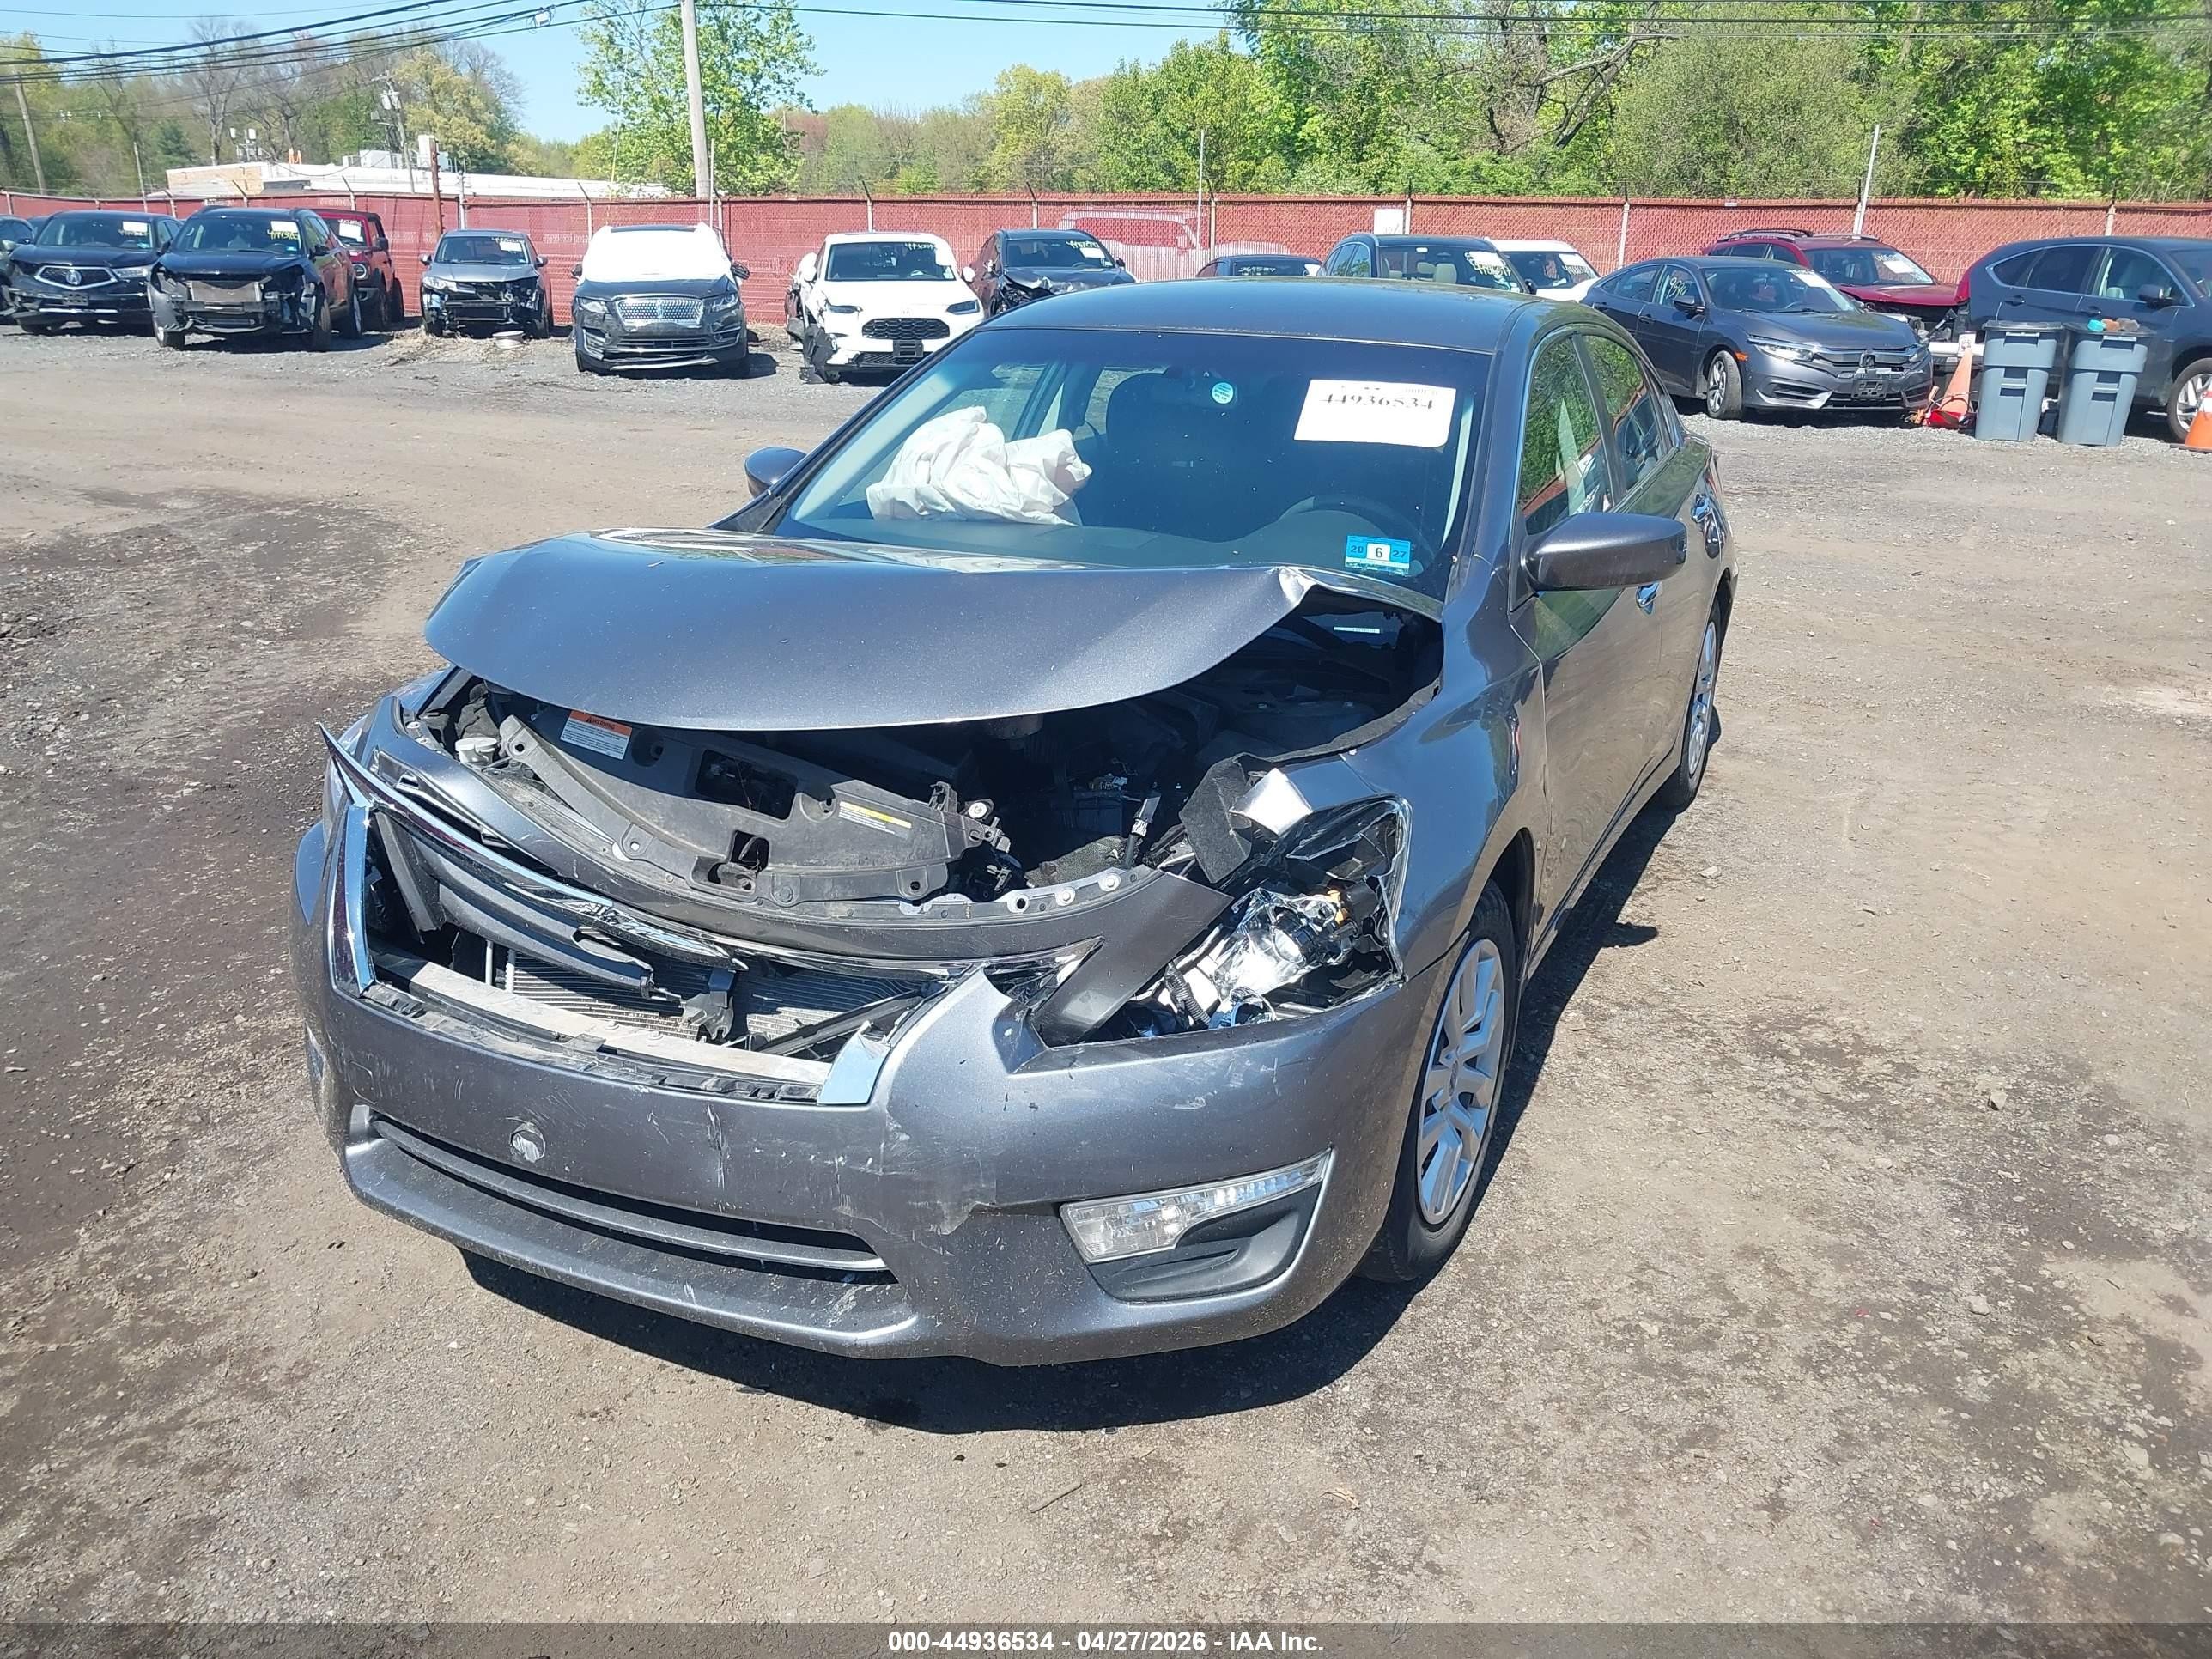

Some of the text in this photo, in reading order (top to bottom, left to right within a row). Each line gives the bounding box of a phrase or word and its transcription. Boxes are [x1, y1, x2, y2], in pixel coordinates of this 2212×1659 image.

[1350, 544, 1407, 558] 20 6 27
